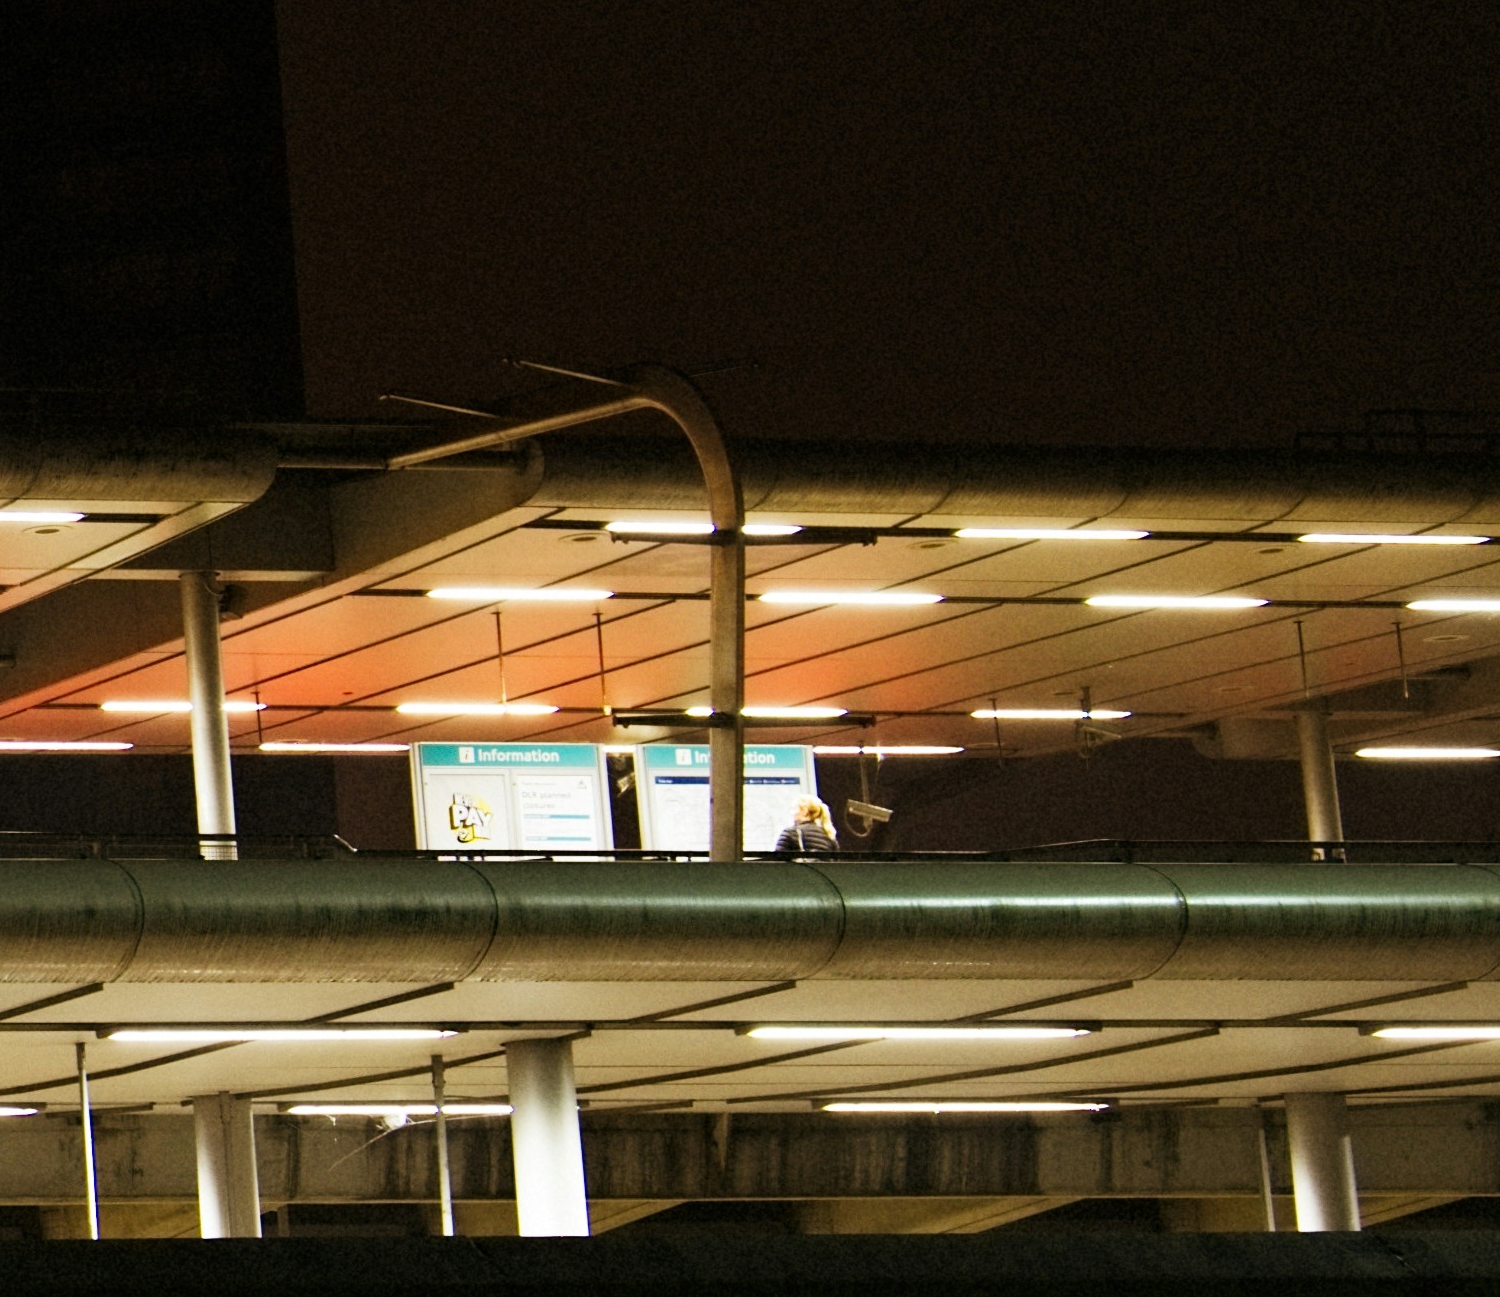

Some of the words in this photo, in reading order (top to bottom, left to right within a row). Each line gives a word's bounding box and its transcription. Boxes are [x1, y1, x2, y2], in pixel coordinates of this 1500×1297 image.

[478, 749, 559, 763] Information
[694, 751, 776, 764] Ination
[453, 804, 494, 835] PAY
